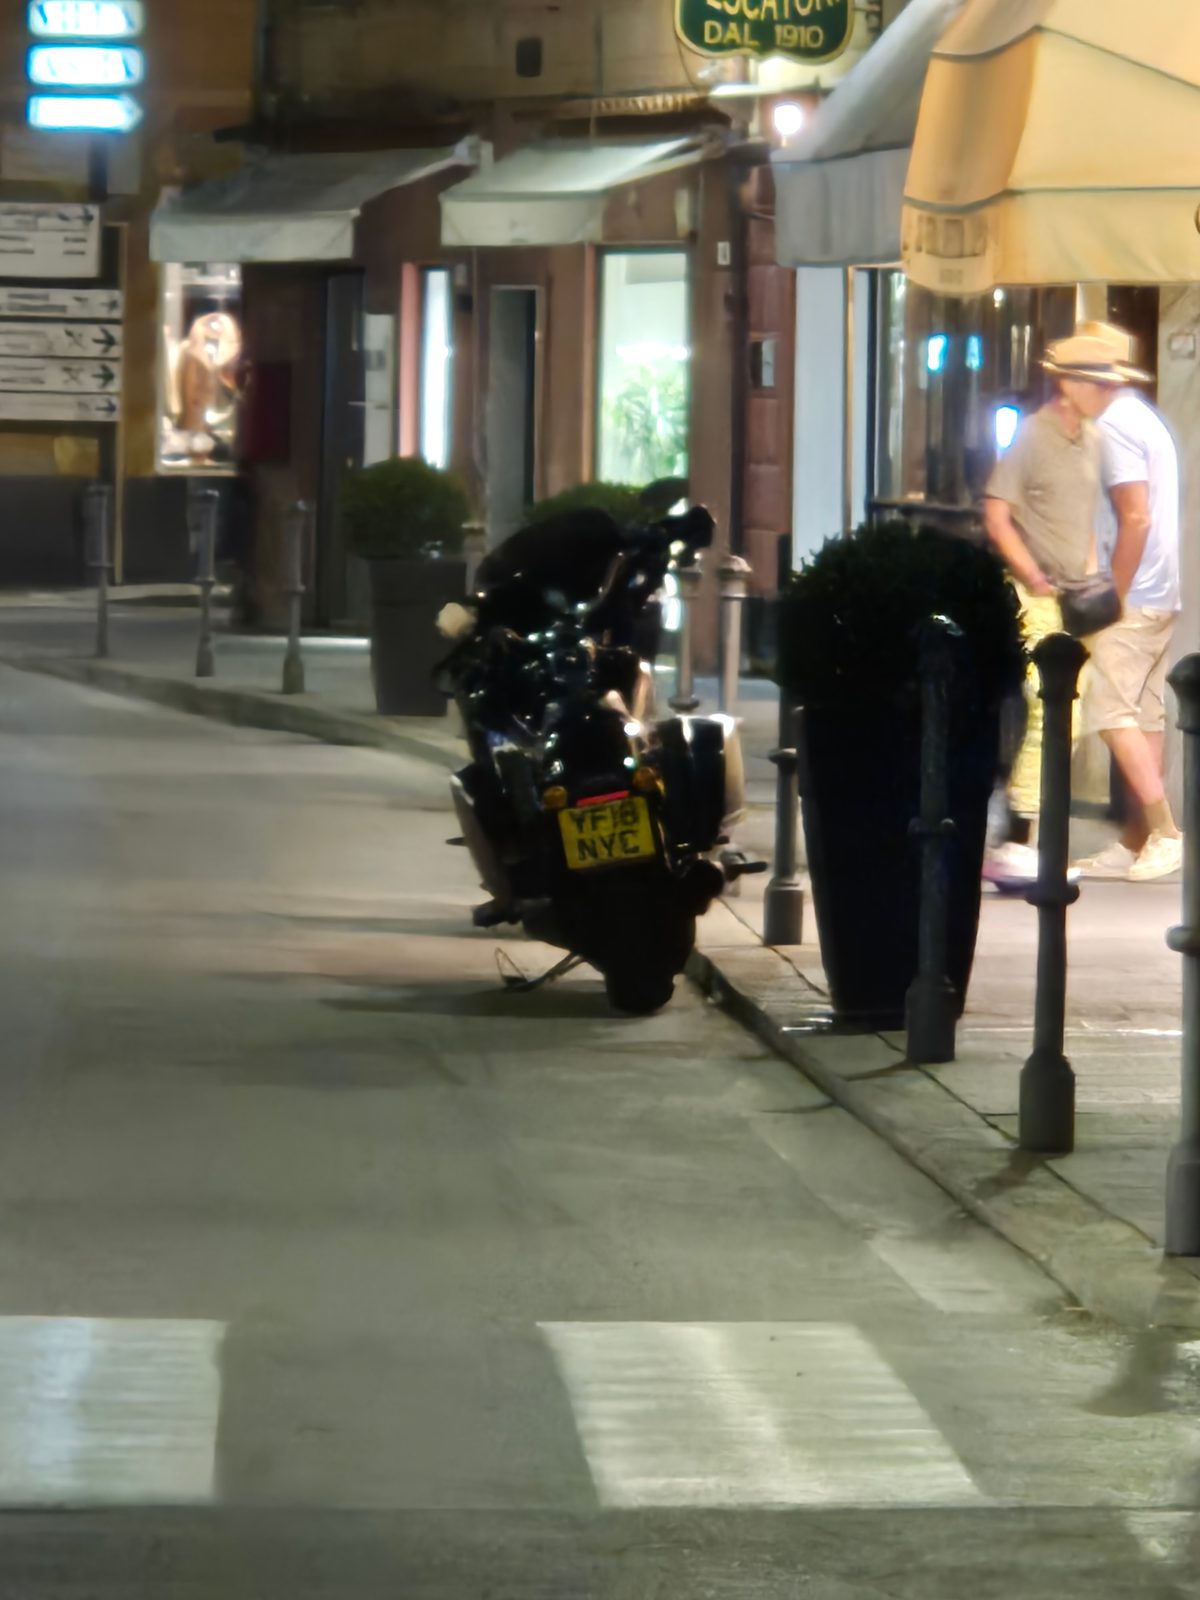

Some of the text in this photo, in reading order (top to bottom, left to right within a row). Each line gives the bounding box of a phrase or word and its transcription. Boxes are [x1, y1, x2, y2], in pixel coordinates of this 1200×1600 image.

[704, 20, 824, 48] DAL 1910
[576, 830, 641, 861] NYC
